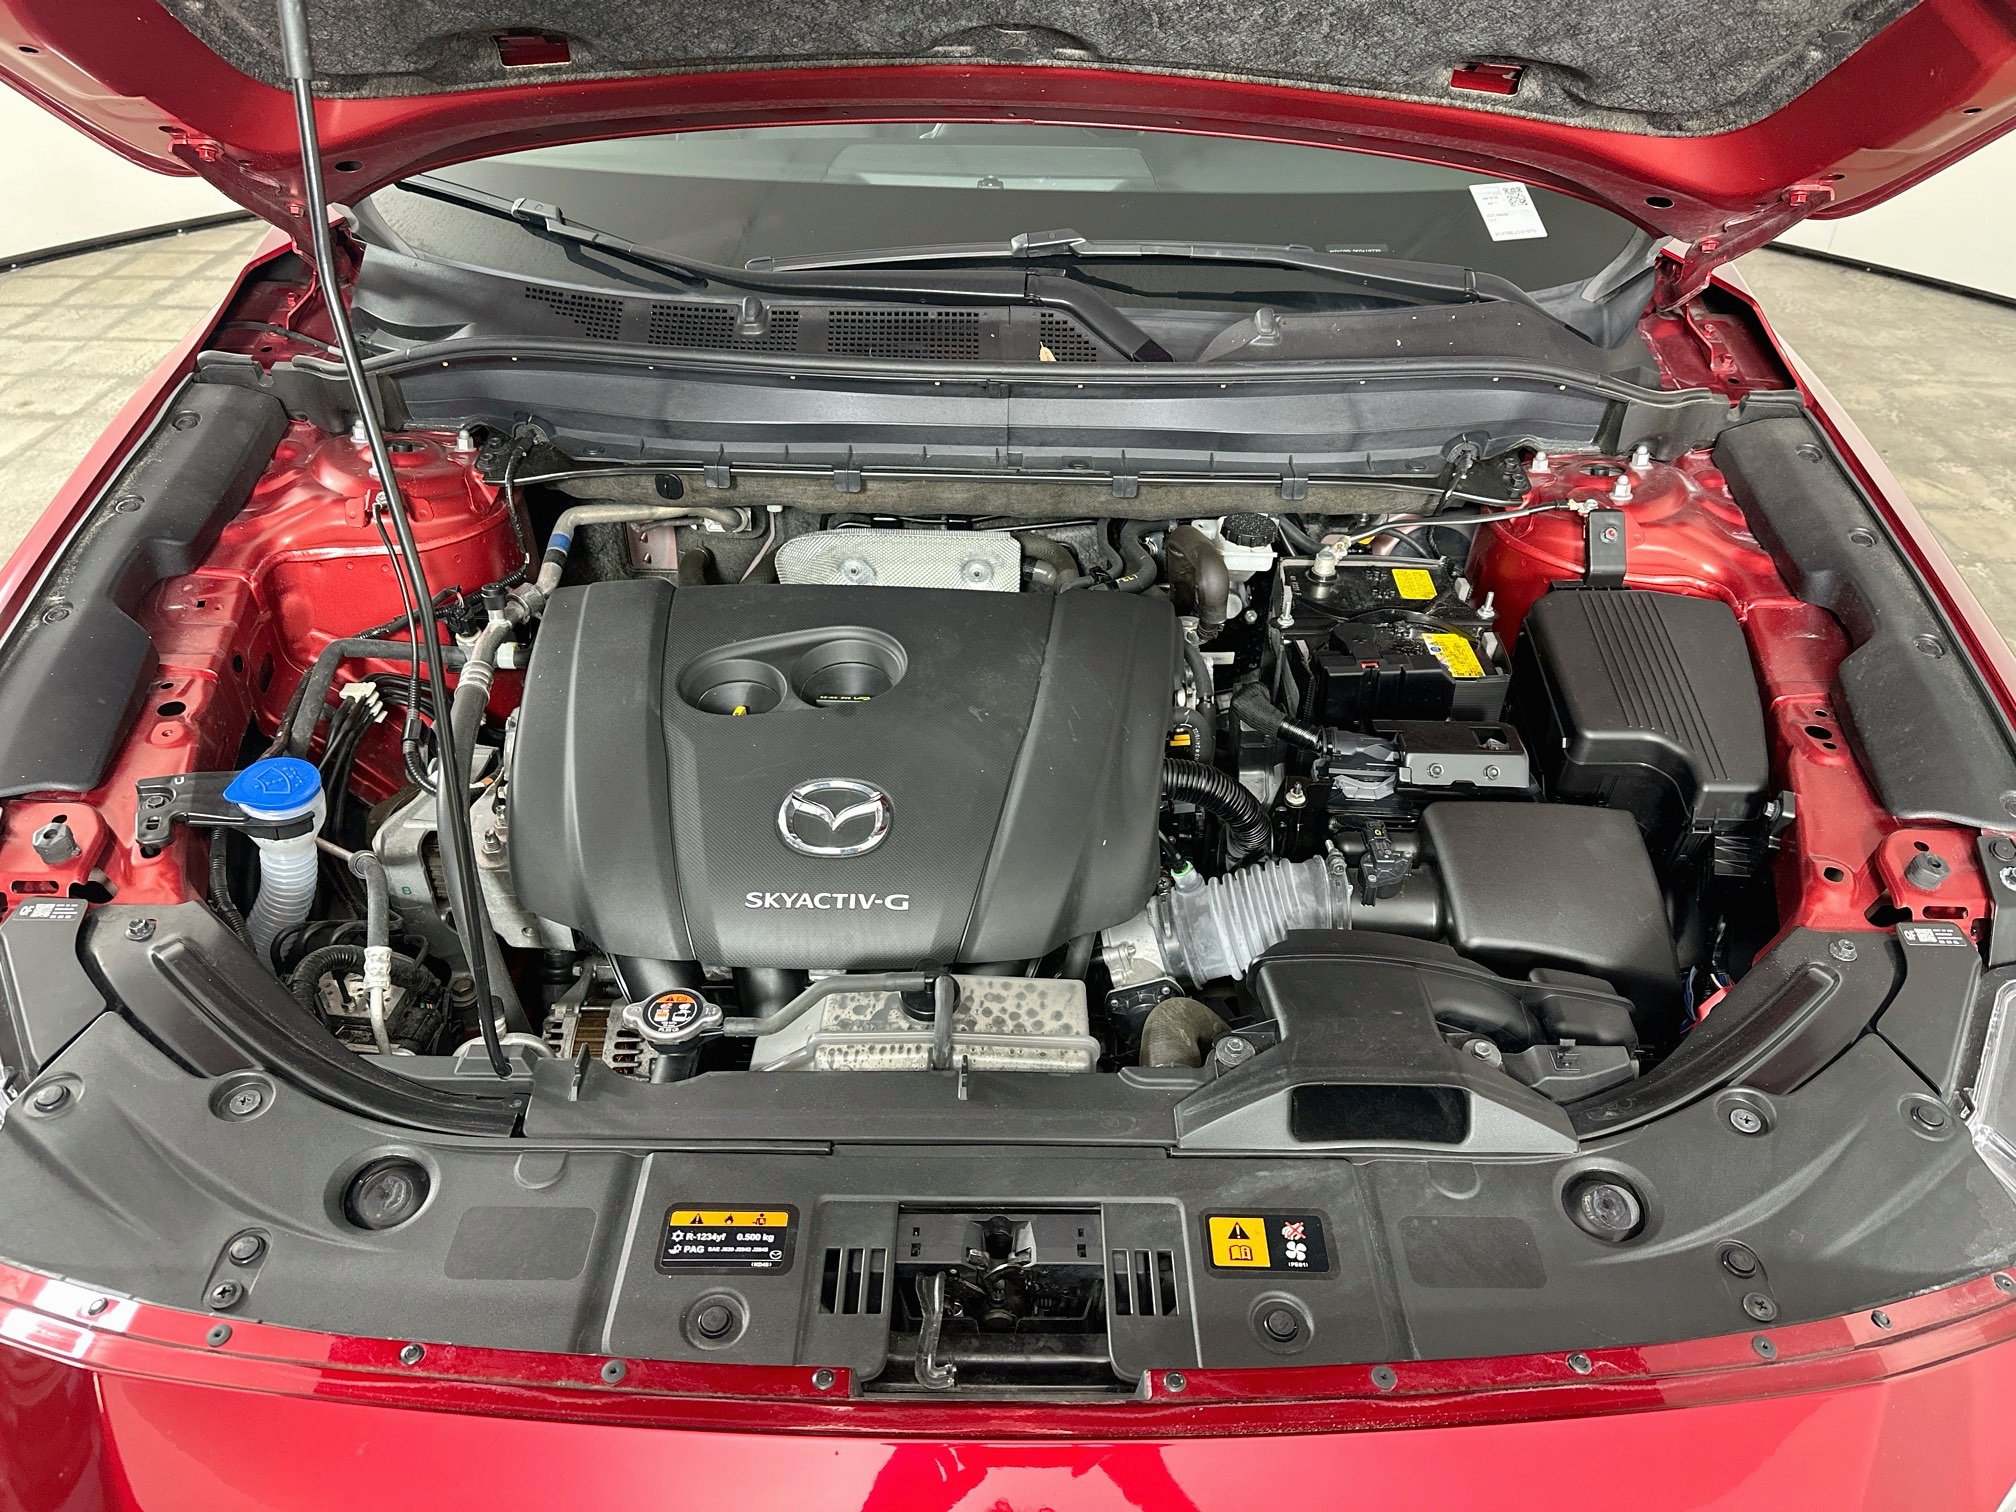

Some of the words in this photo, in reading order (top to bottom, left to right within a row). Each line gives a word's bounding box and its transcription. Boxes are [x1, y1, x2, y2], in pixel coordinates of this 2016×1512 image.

[744, 891, 910, 911] SKYACTIV-G
[685, 1232, 727, 1243] R-1234yf
[736, 1233, 762, 1241] 0.500
[762, 1233, 775, 1243] kg
[683, 1245, 705, 1254] PAG
